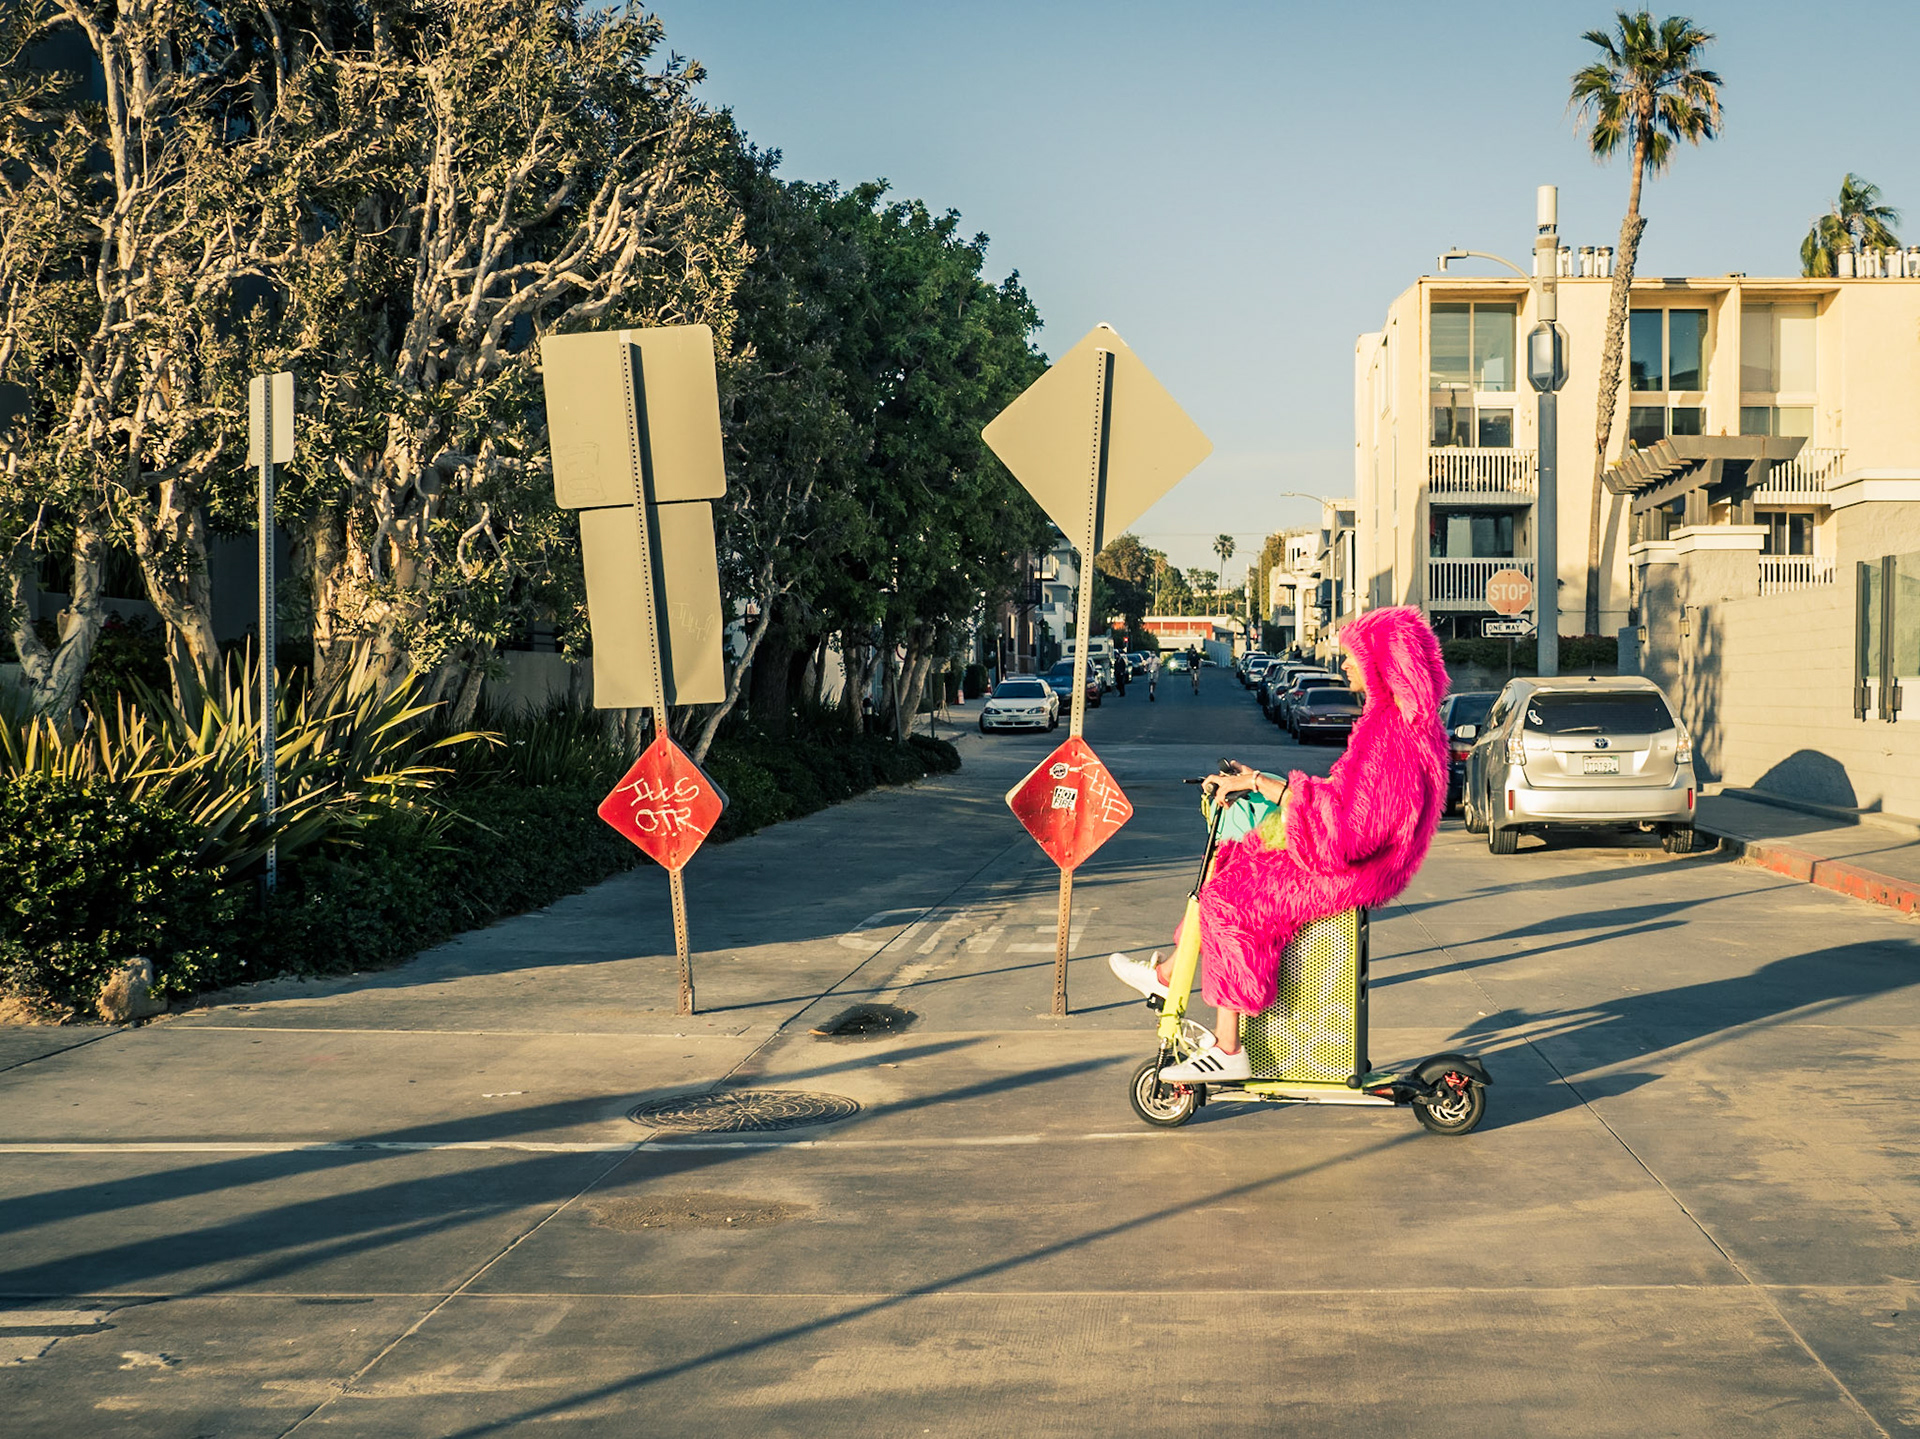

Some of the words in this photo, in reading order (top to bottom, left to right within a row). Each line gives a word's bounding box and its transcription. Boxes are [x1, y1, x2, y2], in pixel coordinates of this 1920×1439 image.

[1490, 584, 1529, 601] STOP
[1488, 624, 1502, 632] ONE
[1505, 624, 1520, 632] WAY
[1054, 787, 1076, 801] HOT
